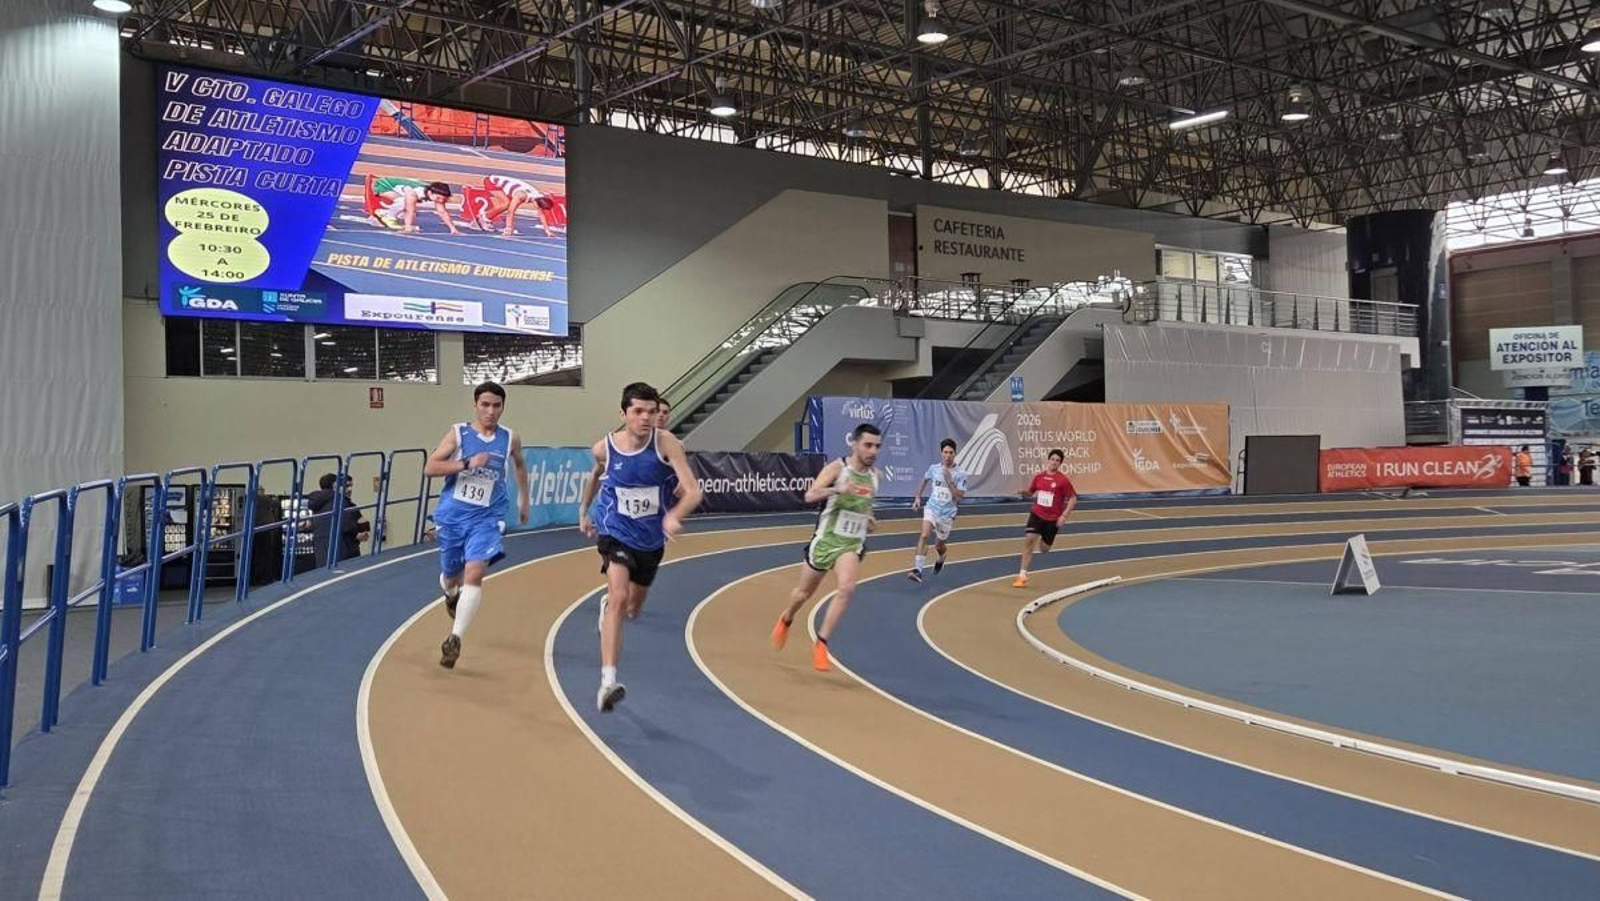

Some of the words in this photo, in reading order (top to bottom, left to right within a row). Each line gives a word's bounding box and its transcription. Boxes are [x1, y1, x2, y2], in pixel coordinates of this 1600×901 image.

[165, 71, 188, 93] V
[192, 77, 256, 104] CTO.
[263, 88, 364, 119] GALEGO
[163, 101, 206, 124] DE
[208, 107, 362, 145] ATLETISMO
[163, 131, 313, 165] ADAPTADO
[164, 160, 248, 187] PISTA
[254, 170, 343, 197] CURTA
[175, 196, 261, 213] MÉRCORES
[197, 211, 215, 220] 25
[220, 212, 240, 222] DE
[175, 220, 261, 236] FREBREIRO
[934, 218, 1005, 240] CAFETERIA
[198, 243, 242, 255] 10:30
[934, 240, 1025, 262] RESTAURANTE
[216, 257, 228, 266] A
[327, 253, 369, 268] PISTA
[373, 256, 393, 269] DE
[395, 258, 470, 275] ATLETISMO
[473, 264, 555, 282] EXPOURENSE
[202, 269, 245, 280] 14:00
[360, 309, 465, 323] Expourense
[1513, 332, 1547, 340] OFICINA
[1496, 341, 1558, 352] ATENCION
[1562, 340, 1578, 350] AL
[1502, 352, 1572, 364] EXPOSITOR
[1017, 413, 1041, 426] 2026
[1017, 430, 1054, 442] VIRTUS
[1055, 430, 1097, 442] WORLD
[1327, 463, 1367, 471] EUROPEAN
[1327, 470, 1367, 478] ATHLETICS
[1376, 464, 1381, 477] I
[1384, 463, 1419, 477] RUN
[1422, 461, 1479, 476] CLEAN
[461, 484, 485, 501] 439
